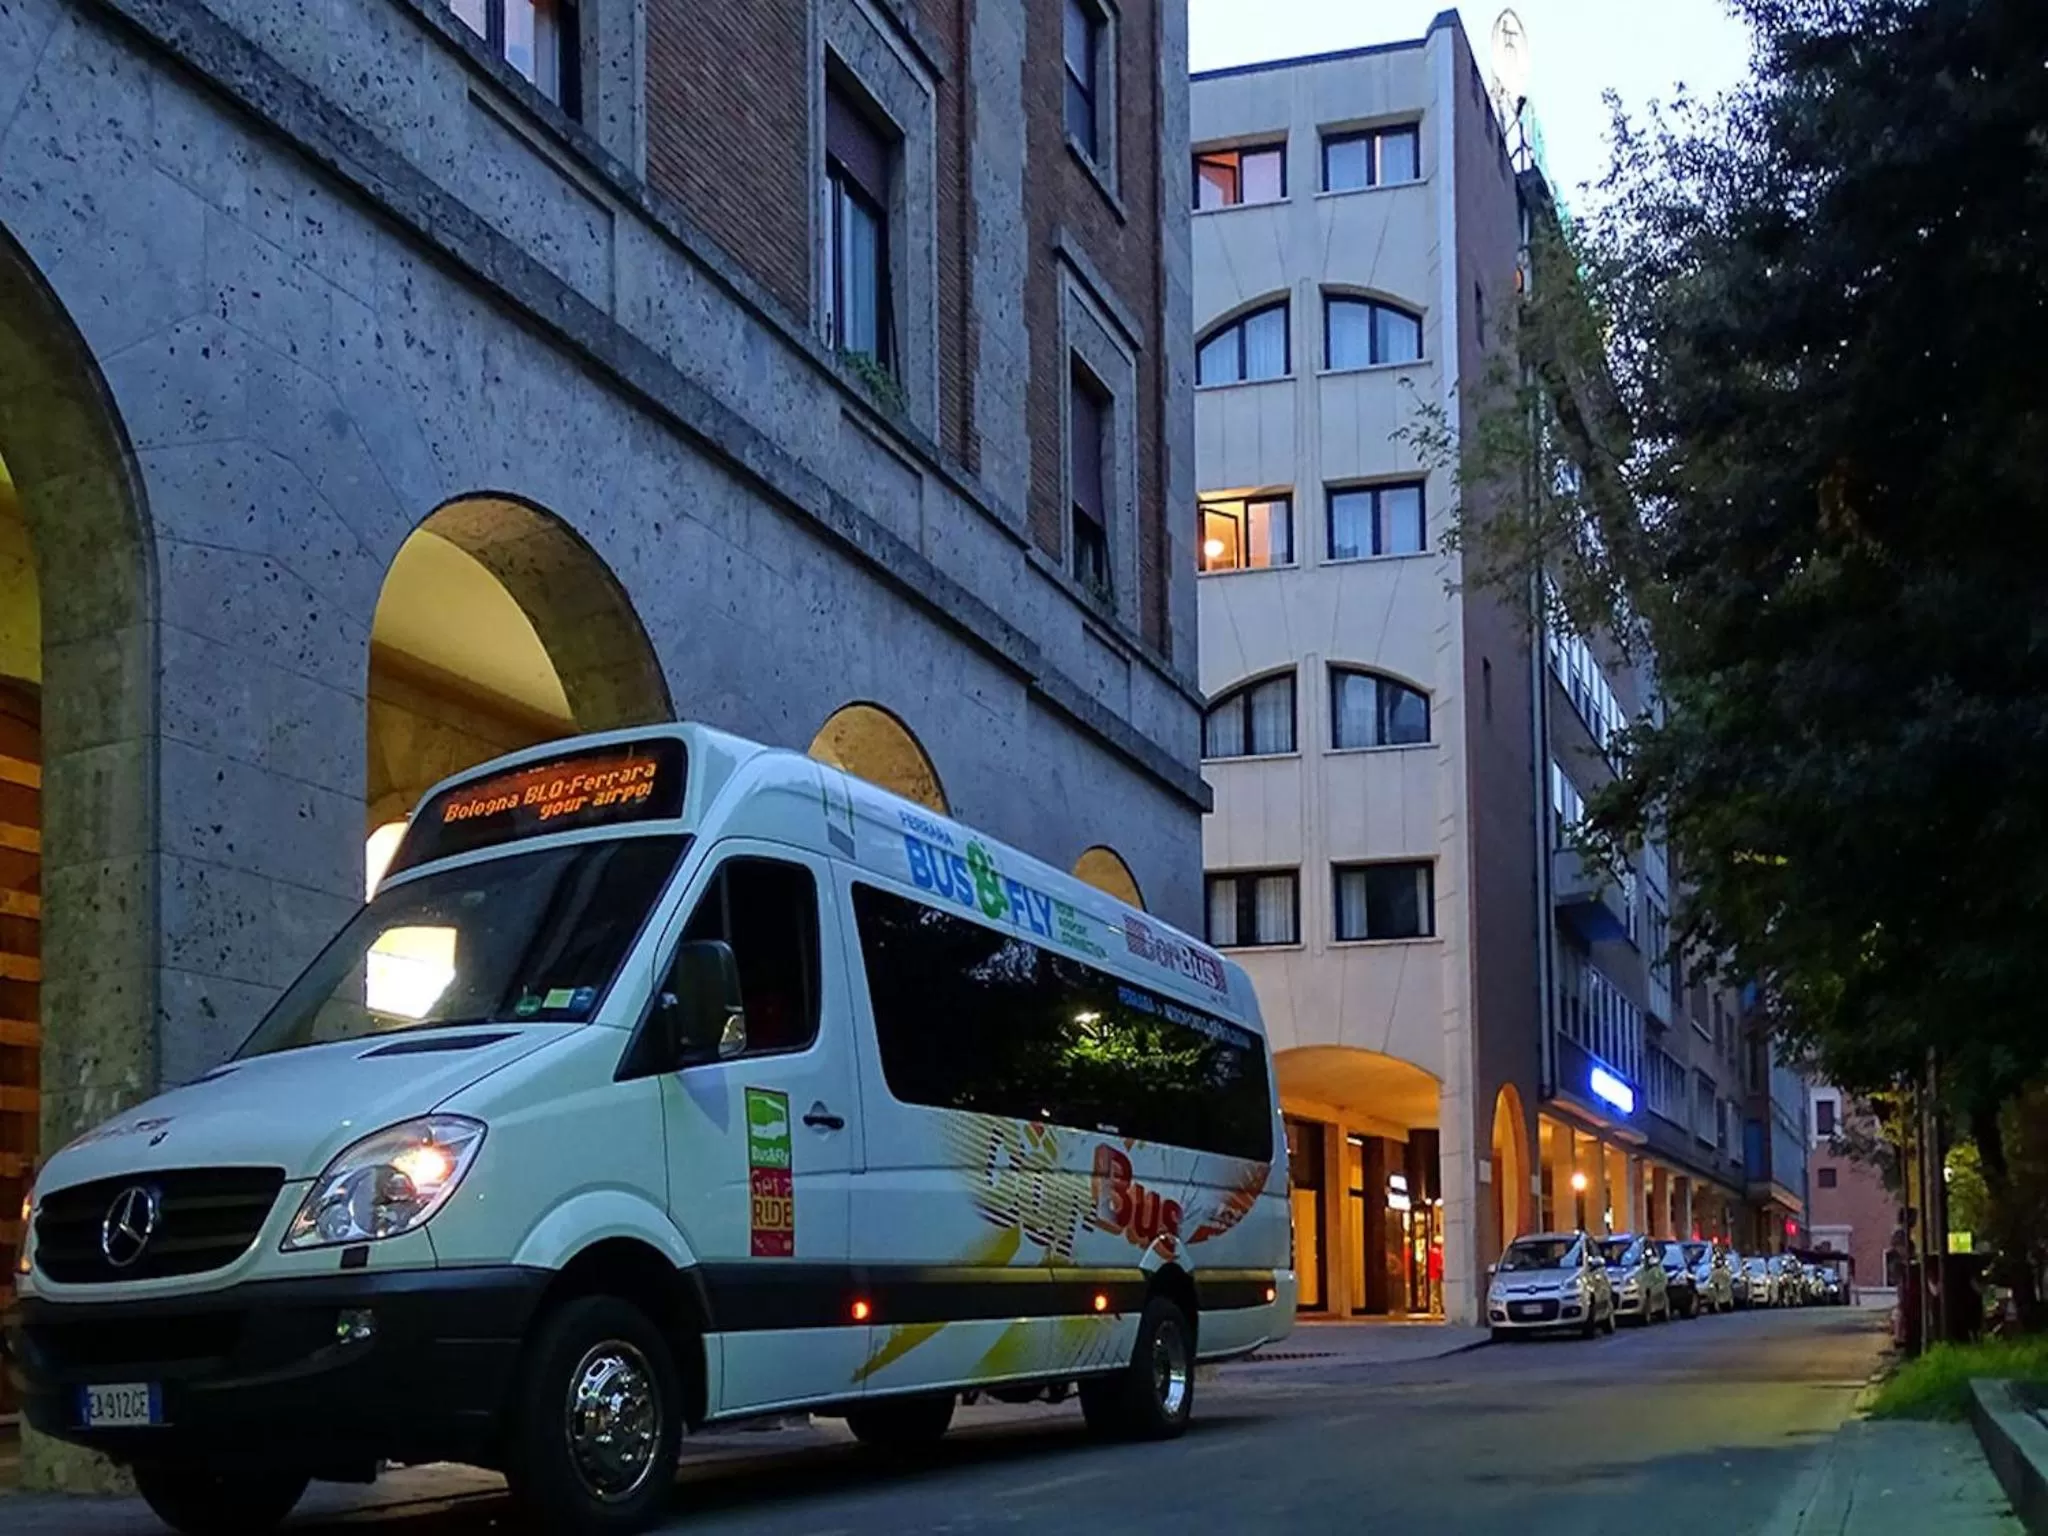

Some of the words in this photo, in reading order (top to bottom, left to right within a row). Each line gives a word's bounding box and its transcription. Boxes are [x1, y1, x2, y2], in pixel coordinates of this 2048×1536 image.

[444, 793, 520, 823] Bologna
[540, 796, 588, 820] your
[753, 1198, 793, 1229] RIDE
